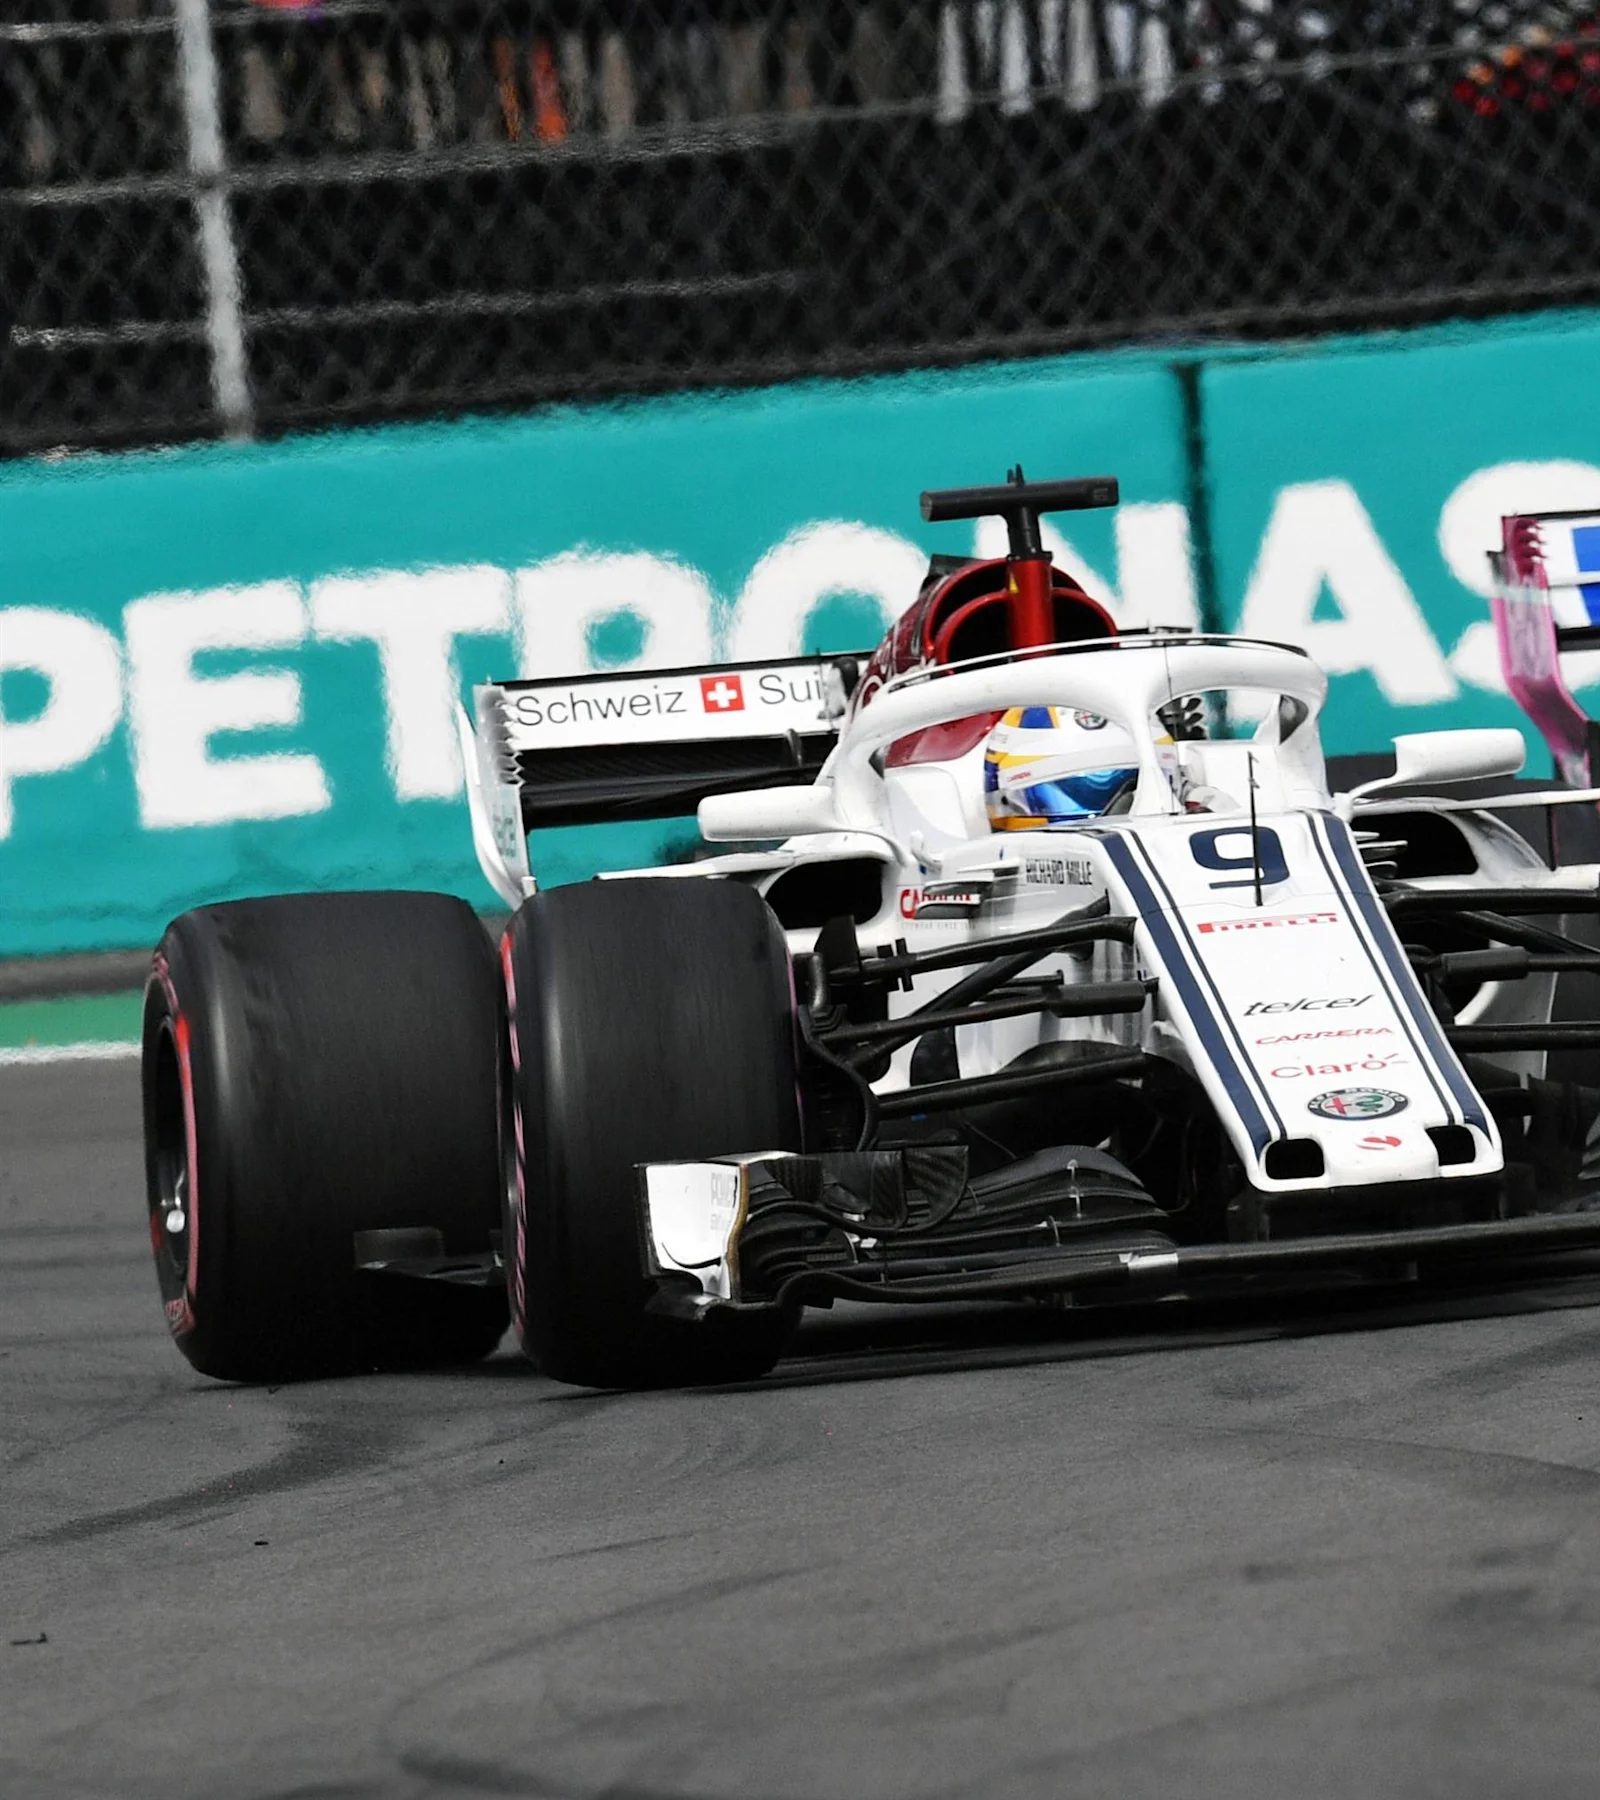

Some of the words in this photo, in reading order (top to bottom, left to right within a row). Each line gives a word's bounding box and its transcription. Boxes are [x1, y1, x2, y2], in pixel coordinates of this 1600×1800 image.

[516, 685, 688, 727] Schweiz
[1189, 825, 1290, 890] 9
[1243, 994, 1375, 1017] telcel
[1255, 1027, 1395, 1046] CARRERA
[1270, 1056, 1390, 1079] Claro
